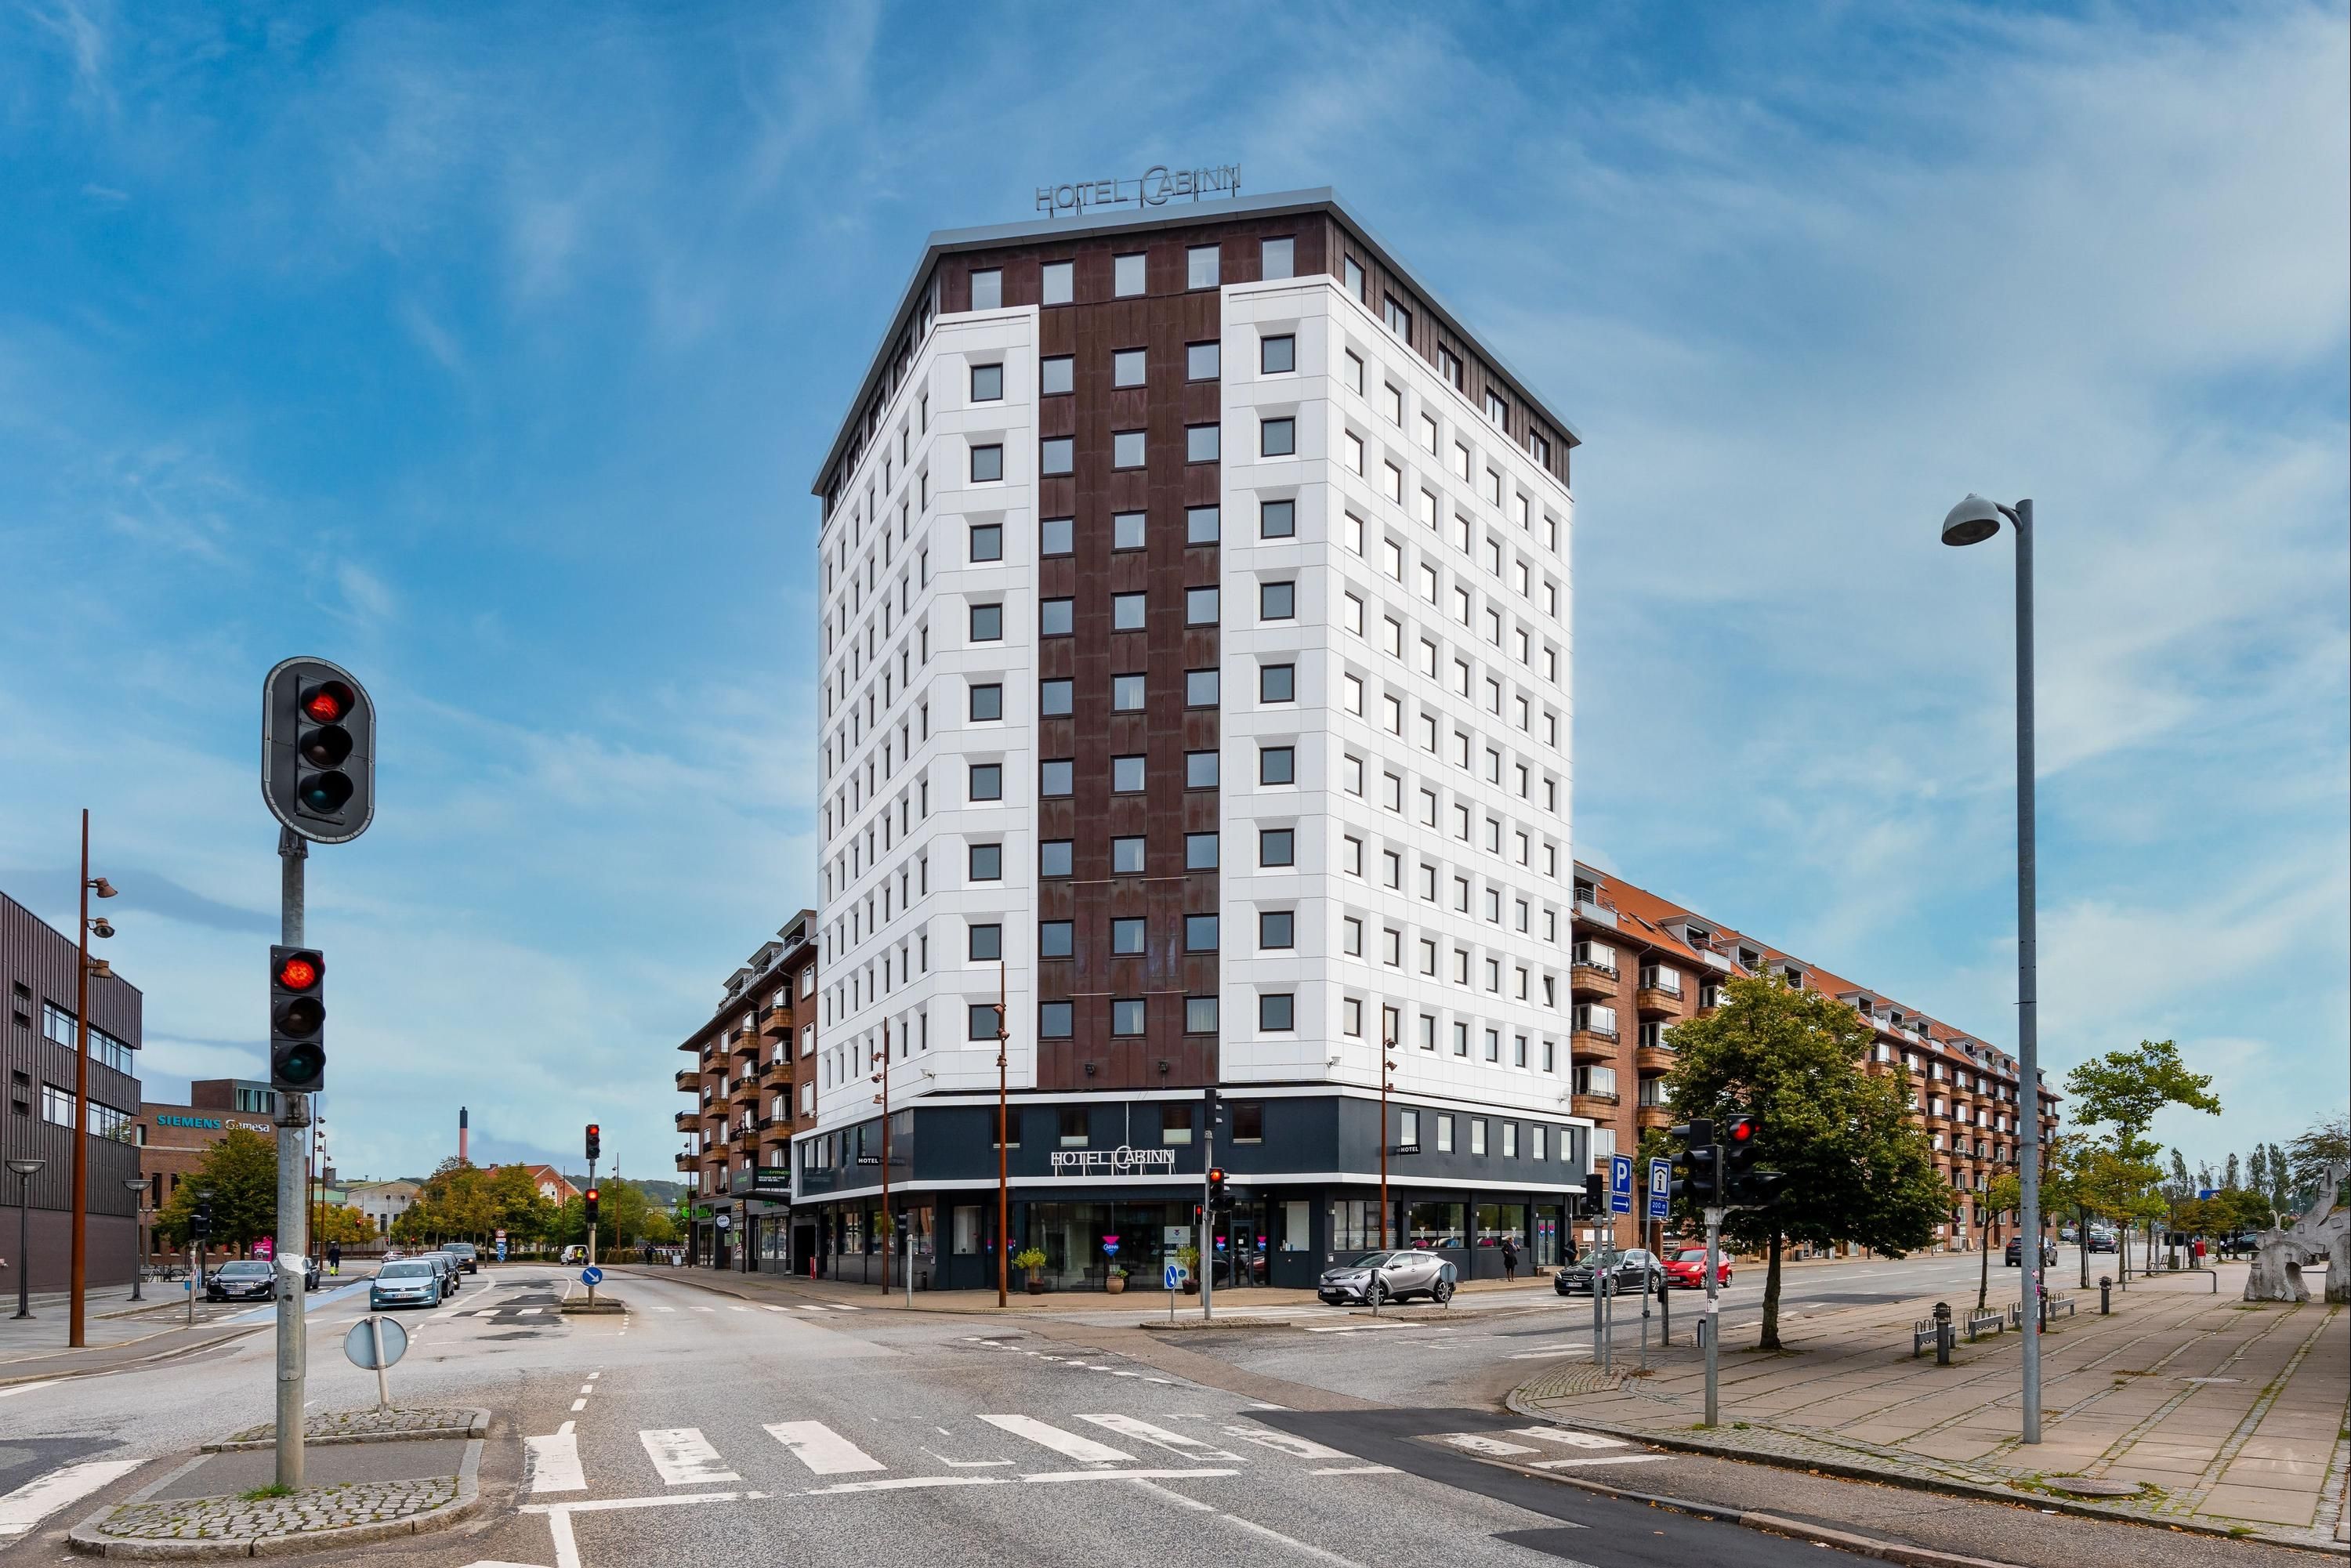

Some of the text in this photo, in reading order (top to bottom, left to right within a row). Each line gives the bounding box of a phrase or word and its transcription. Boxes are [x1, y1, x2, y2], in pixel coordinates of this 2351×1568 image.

[1035, 163, 1241, 211] HOTEL CABINN
[157, 1115, 222, 1129] SIEMENS
[1051, 1145, 1175, 1169] HOTEL CABINN
[1617, 1162, 1627, 1188] P
